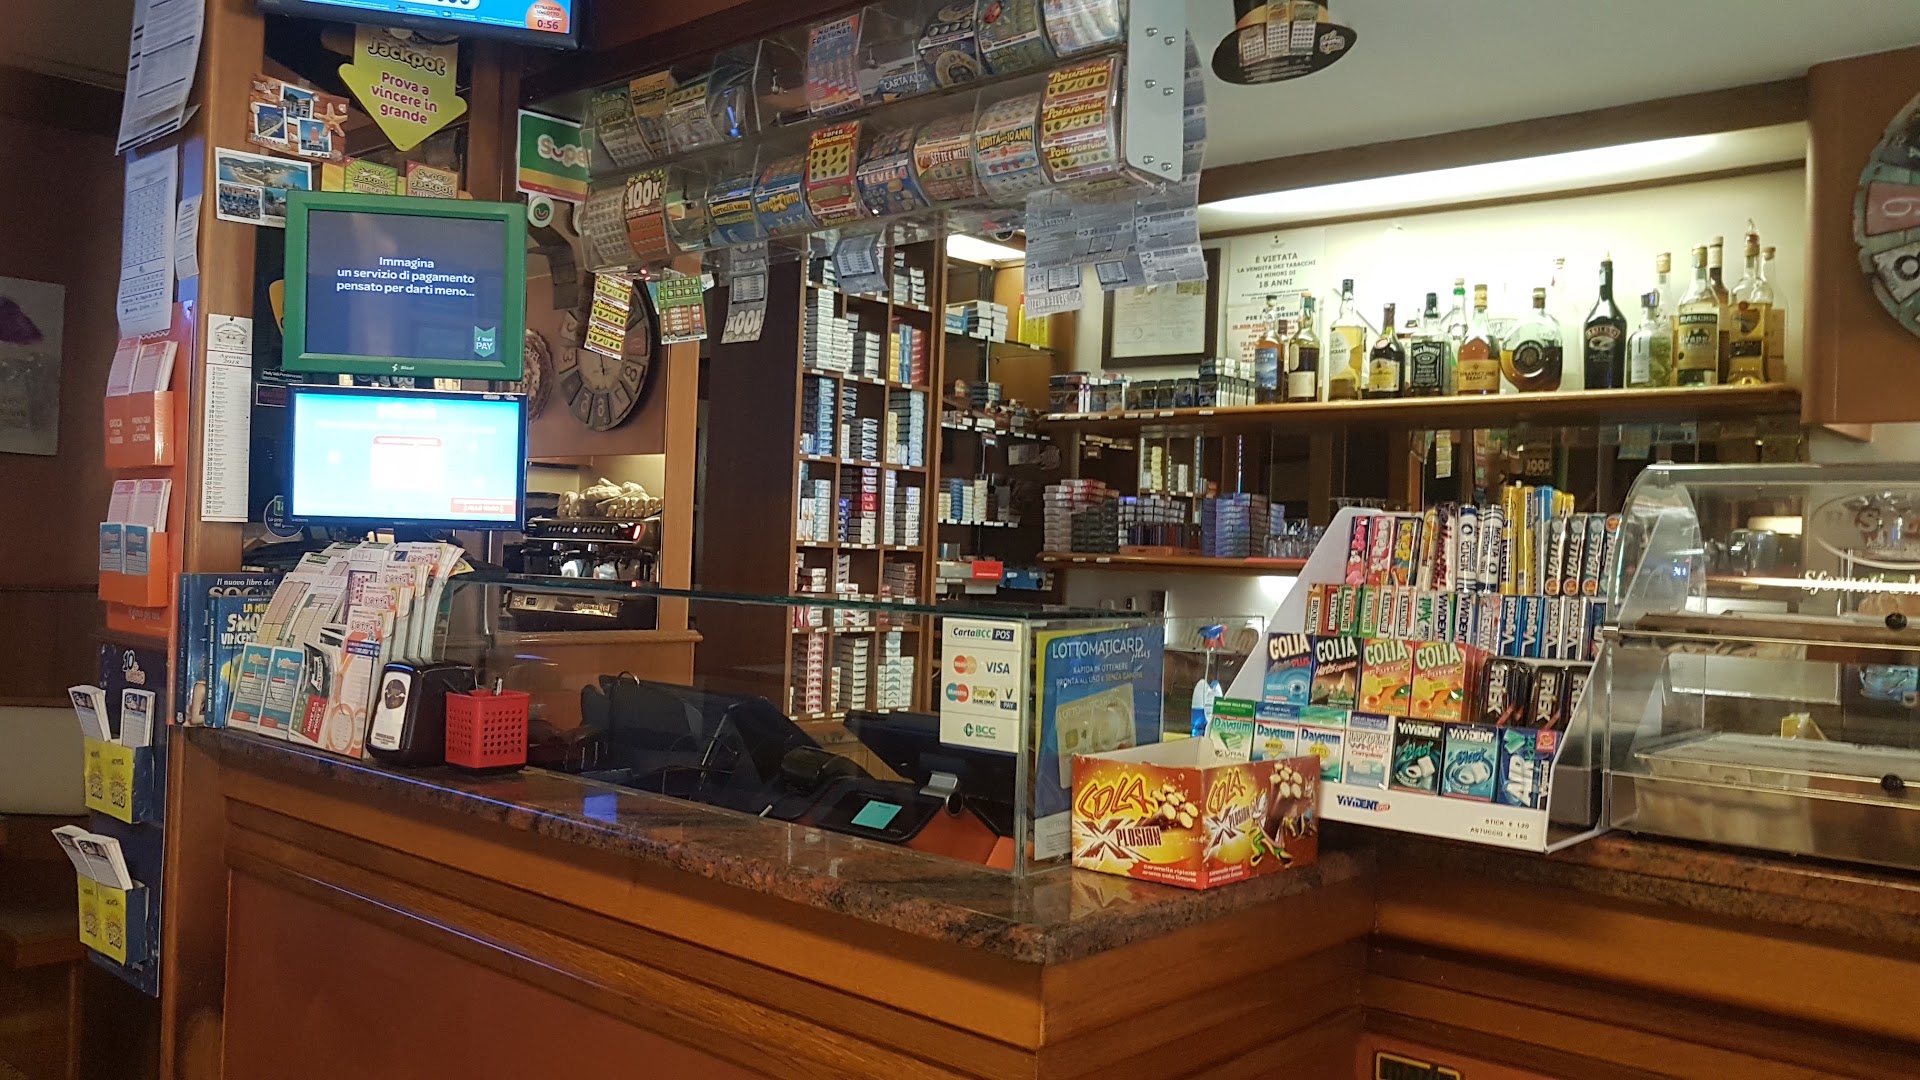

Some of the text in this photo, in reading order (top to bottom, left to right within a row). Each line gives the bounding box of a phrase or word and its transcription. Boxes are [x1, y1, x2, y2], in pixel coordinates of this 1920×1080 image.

[537, 20, 559, 29] 0:56
[367, 41, 446, 75] Jackpot
[382, 72, 430, 96] Prova a
[372, 85, 438, 113] vincere in
[380, 104, 428, 124] grande
[379, 256, 435, 269] Immagina
[1263, 252, 1298, 263] VIETATA
[1246, 264, 1272, 273] VENDITA
[1286, 259, 1317, 269] TABACCHI
[337, 269, 475, 284] un servizio di pagamento
[1259, 278, 1293, 289] 18 ANNI
[336, 282, 475, 297] pensato per darti meno...
[475, 342, 493, 350] PAY
[1501, 519, 1513, 583] ments
[1547, 534, 1560, 578] HALLS
[1566, 533, 1581, 577] HALLS
[1585, 533, 1600, 576] HALLS
[217, 578, 222, 586] Il
[243, 603, 253, 613] LA
[1341, 593, 1351, 629] BROOKLYN
[1364, 594, 1374, 631] BROOKLYN
[953, 626, 1011, 640] CartaBCC POS
[1052, 637, 1144, 660] LOTTOMATICARD
[986, 661, 1010, 674] VISA
[1073, 666, 1094, 675] RAPIDA
[1101, 662, 1129, 672] OTTENERE
[1005, 688, 1014, 700] V
[1487, 665, 1505, 714] FRISK
[1537, 672, 1556, 721] FRISK
[975, 725, 996, 735] BCC
[1214, 717, 1250, 733] Daygum
[1256, 724, 1296, 739] Daygum
[1301, 729, 1341, 744] Daygum
[1506, 755, 1534, 807] AIR
[1075, 771, 1150, 821] COLA
[1206, 767, 1247, 815] COLA
[1470, 827, 1503, 837] ASTUCCIO
